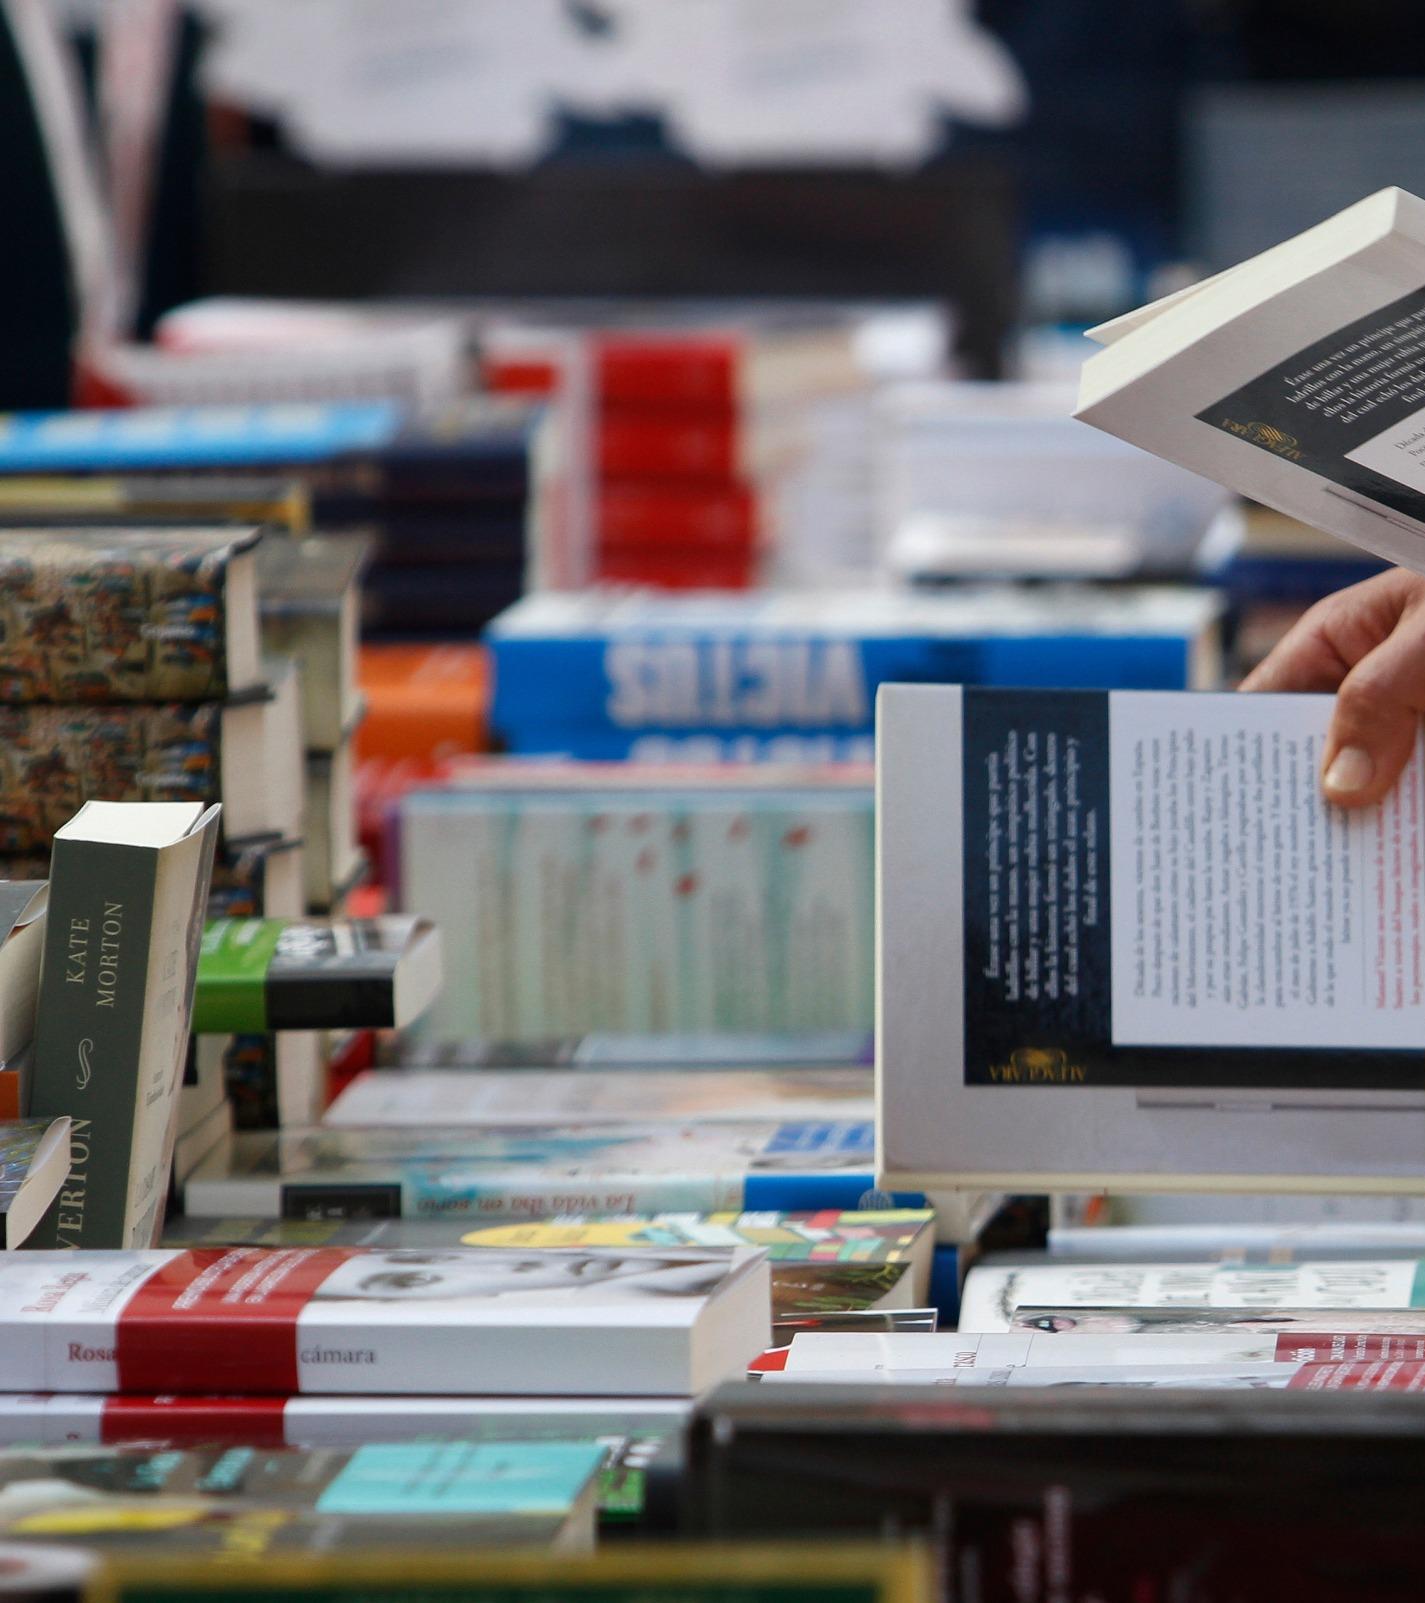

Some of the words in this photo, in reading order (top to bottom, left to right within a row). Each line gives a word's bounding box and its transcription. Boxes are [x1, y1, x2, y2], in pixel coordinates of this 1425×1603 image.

[1284, 370, 1314, 386] Érase
[1312, 359, 1332, 372] una
[1329, 351, 1346, 361] vez
[1345, 344, 1361, 353] un
[1358, 326, 1396, 347] príncipe
[1394, 317, 1413, 328] que
[1286, 380, 1326, 403] ladrillos
[1325, 369, 1344, 381] con
[1380, 342, 1396, 351] un
[1305, 401, 1321, 410] de
[1315, 386, 1344, 402] billar
[1341, 382, 1353, 390] y
[1349, 372, 1370, 384] una
[1367, 357, 1395, 374] mujer
[1394, 345, 1421, 359] rubia
[1323, 403, 1346, 417] ellos
[1340, 397, 1356, 405] la
[1350, 378, 1389, 399] historia
[1384, 362, 1416, 379] formó
[1340, 411, 1359, 424] del
[1357, 399, 1378, 414] cual
[1376, 388, 1399, 403] echó
[1393, 381, 1413, 391] los
[66, 917, 90, 984] KATE
[96, 900, 124, 1009] MORTON
[552, 1196, 598, 1216] vida
[68, 1343, 118, 1362] Rosa
[300, 1345, 376, 1364] cámara
